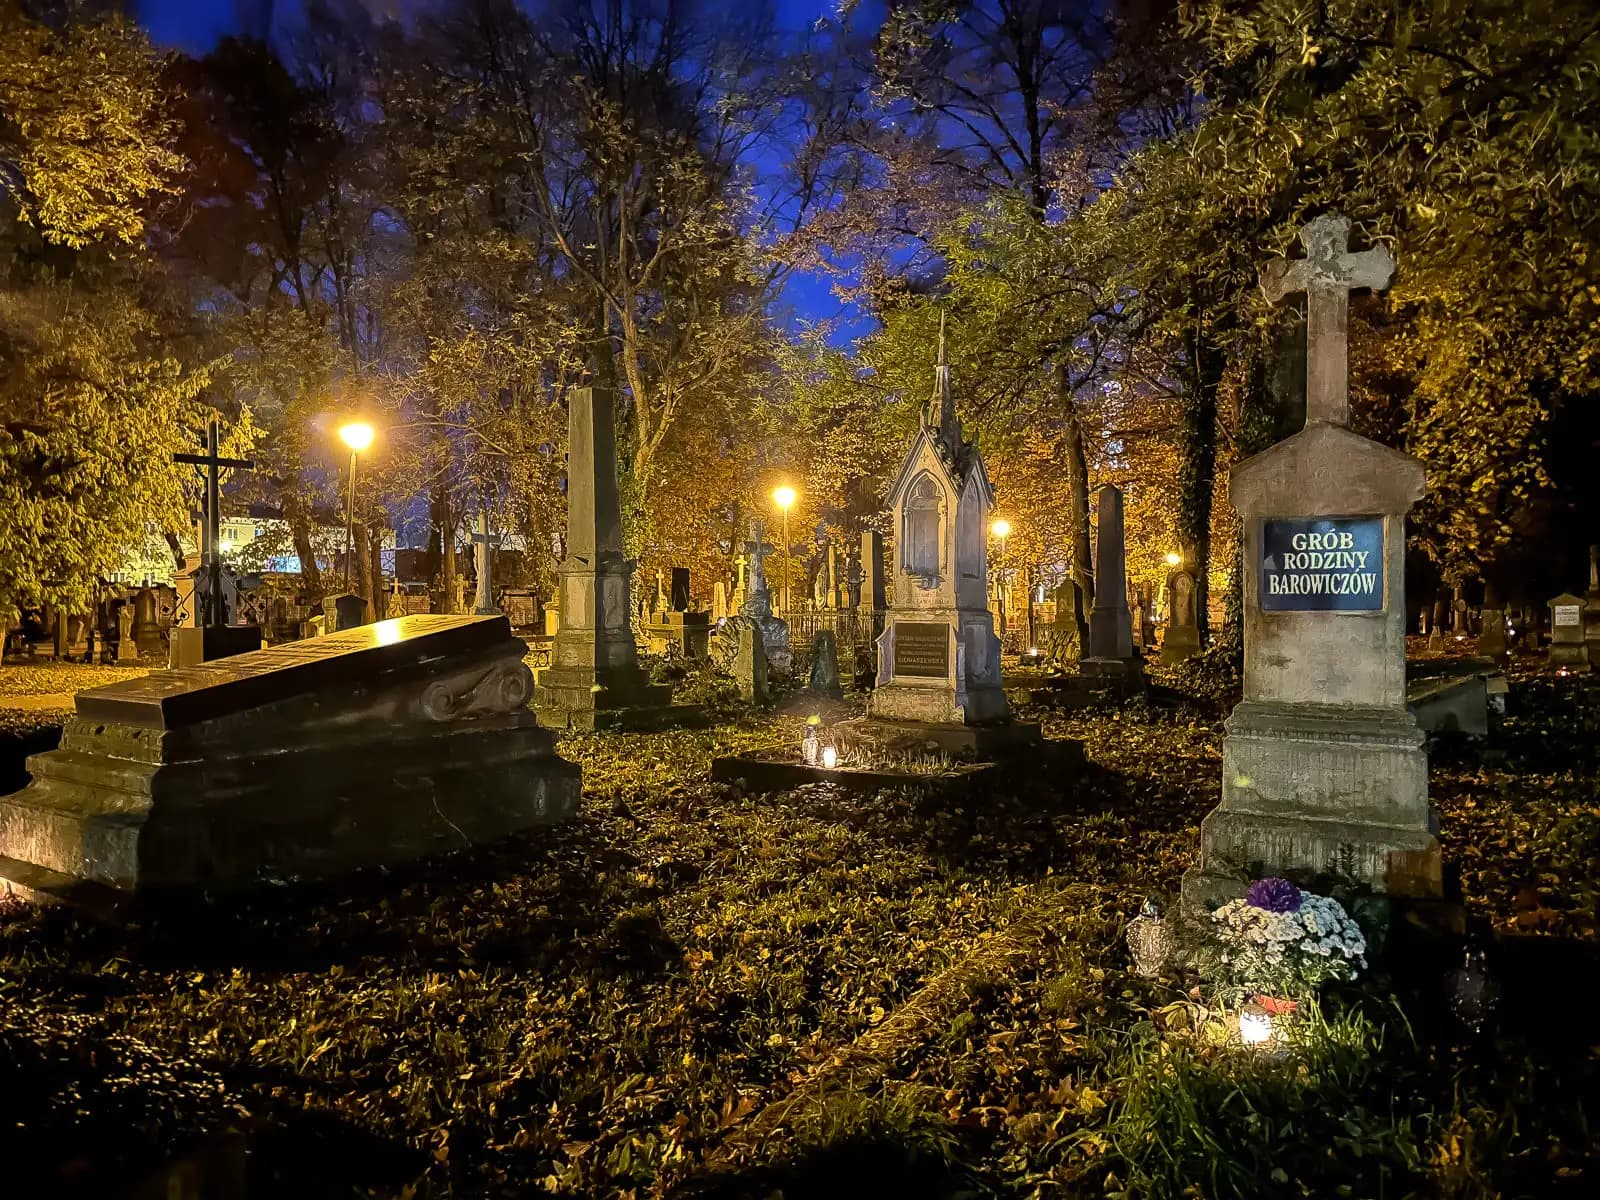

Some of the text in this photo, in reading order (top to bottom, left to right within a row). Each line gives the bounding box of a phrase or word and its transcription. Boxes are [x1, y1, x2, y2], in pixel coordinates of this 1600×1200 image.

[1292, 528, 1354, 550] GRÓB
[1283, 551, 1369, 570] RODZINY
[1269, 569, 1376, 595] BAROWICZÓW
